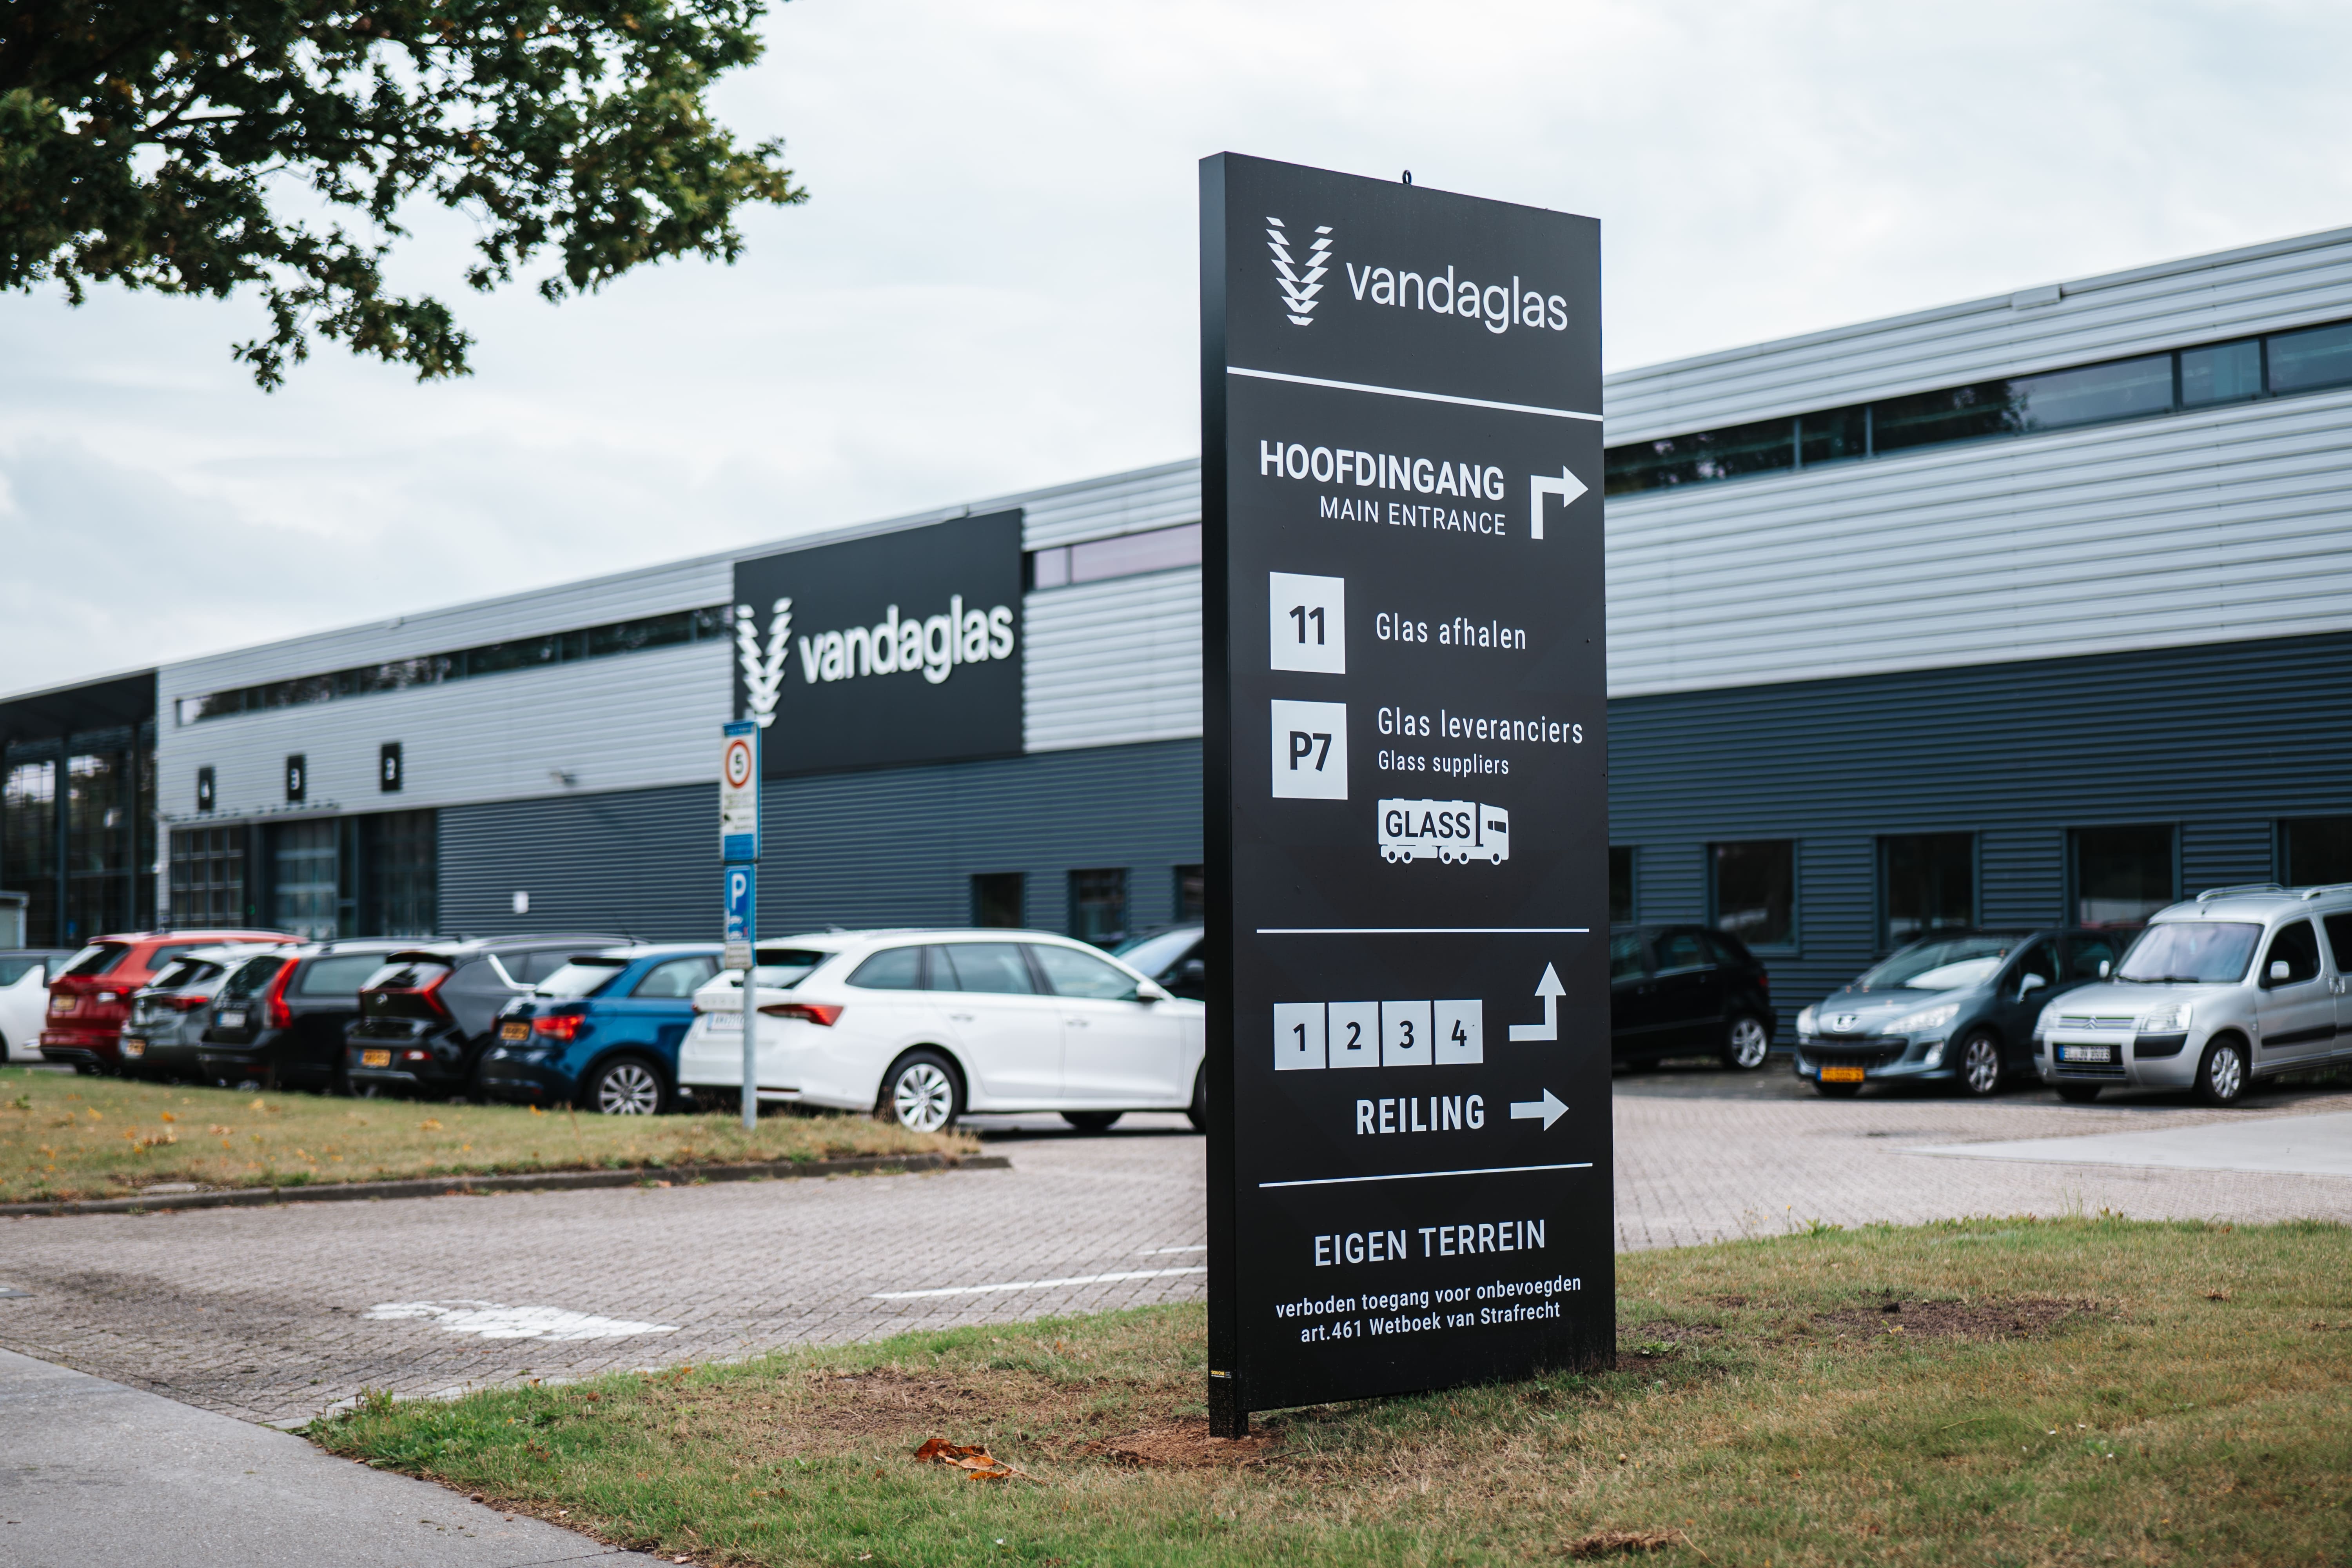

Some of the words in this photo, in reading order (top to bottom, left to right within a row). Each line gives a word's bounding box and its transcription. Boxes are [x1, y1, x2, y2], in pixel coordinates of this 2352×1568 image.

[1346, 262, 1568, 334] vandaglas
[1261, 440, 1504, 500] HOOFDINGANG
[1321, 495, 1378, 523] MAIN
[1389, 504, 1505, 535] ENTRANCE
[798, 593, 1014, 684] vandaglas
[1289, 605, 1325, 645] 11
[1376, 613, 1428, 643] Glas
[1439, 617, 1525, 650] afhalen
[1378, 707, 1430, 737] Glas
[1441, 709, 1583, 744] leveranciers
[734, 753, 744, 774] 5
[1290, 731, 1332, 772] P7
[1379, 750, 1425, 771] Glass
[1433, 753, 1509, 778] suppliers
[1385, 810, 1470, 839] GLASS
[731, 873, 747, 910] P
[1293, 1023, 1305, 1051] 1
[1346, 1022, 1361, 1050] 2
[1399, 1020, 1414, 1049] 3
[1451, 1019, 1467, 1047] 4
[1357, 1094, 1484, 1135] REILING
[1315, 1229, 1406, 1266] EIGEN
[1418, 1219, 1544, 1257] TERREIN
[1276, 1295, 1356, 1318] verboden
[1361, 1291, 1429, 1312] toegang
[1435, 1287, 1470, 1303] voor
[1477, 1275, 1581, 1297] onbevoegden
[1301, 1320, 1361, 1343] art.461
[1369, 1312, 1441, 1335] Wetboek
[1447, 1312, 1474, 1328] van
[1481, 1301, 1560, 1324] Strafrecht
